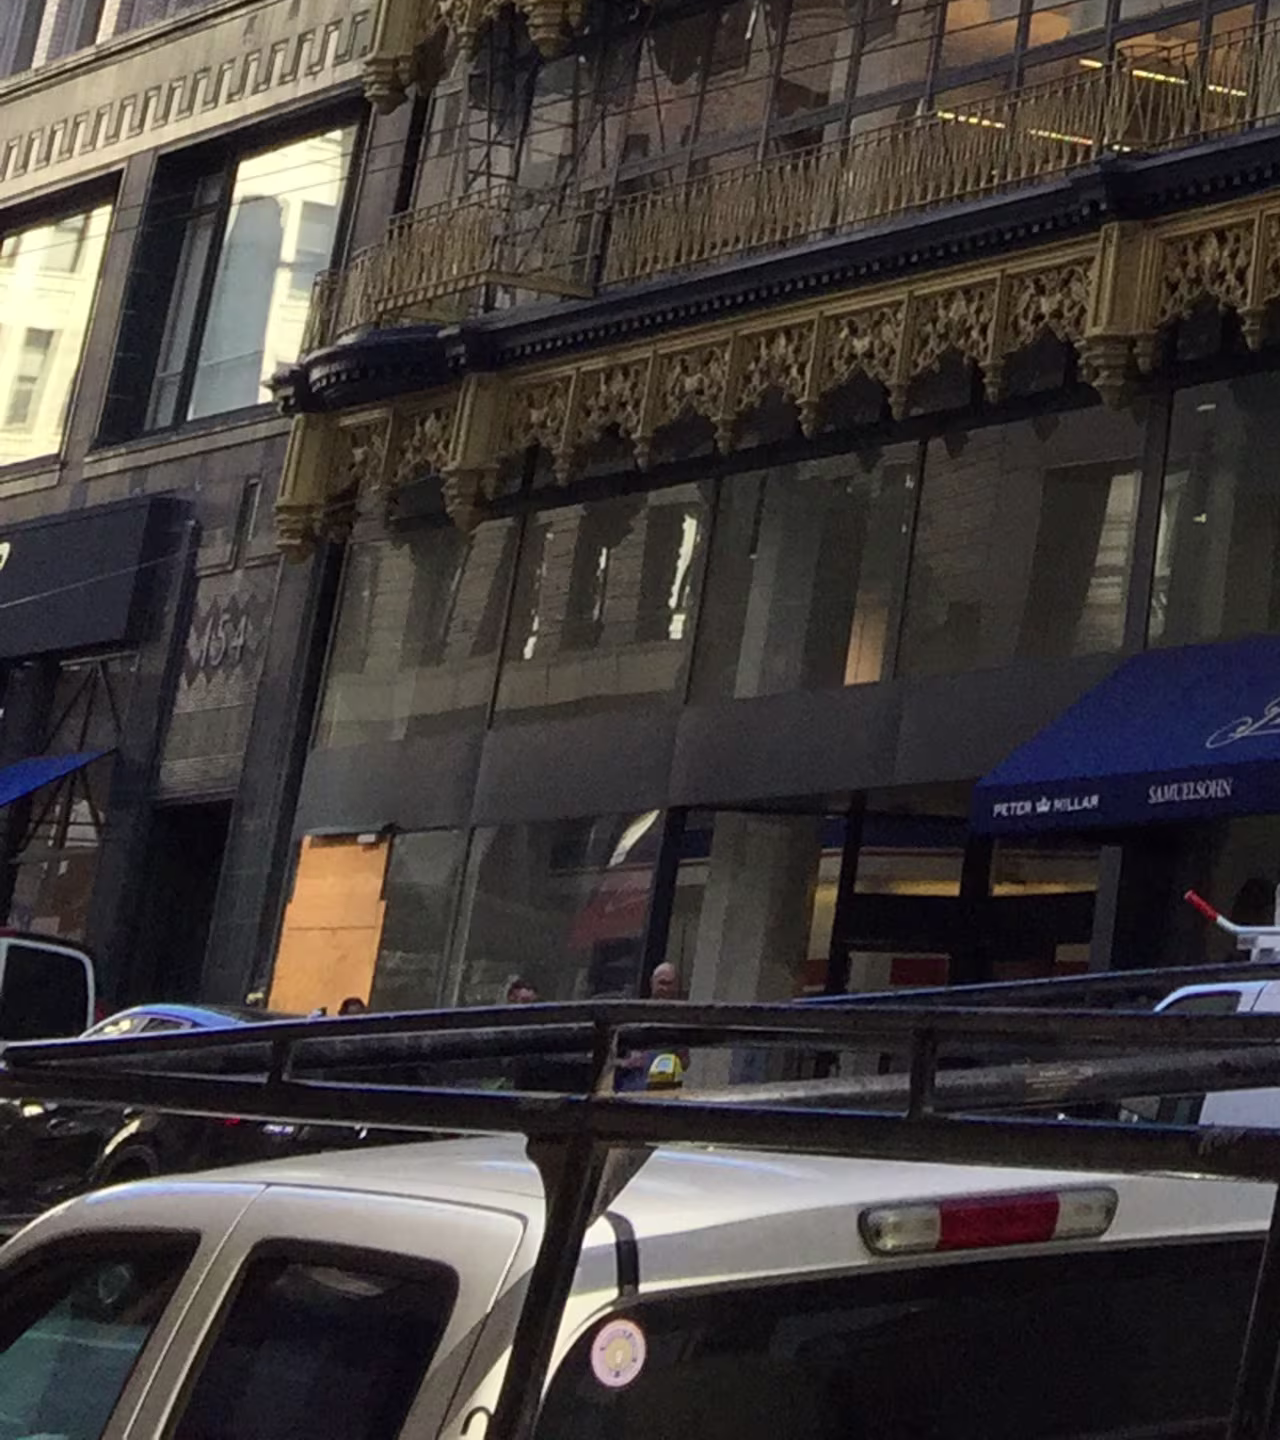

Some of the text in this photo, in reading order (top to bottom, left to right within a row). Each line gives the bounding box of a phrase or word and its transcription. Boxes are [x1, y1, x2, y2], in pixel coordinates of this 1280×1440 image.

[199, 613, 249, 668] 154
[1147, 776, 1234, 804] SAMUELSOHN
[992, 794, 1100, 819] PETER MILLAR
